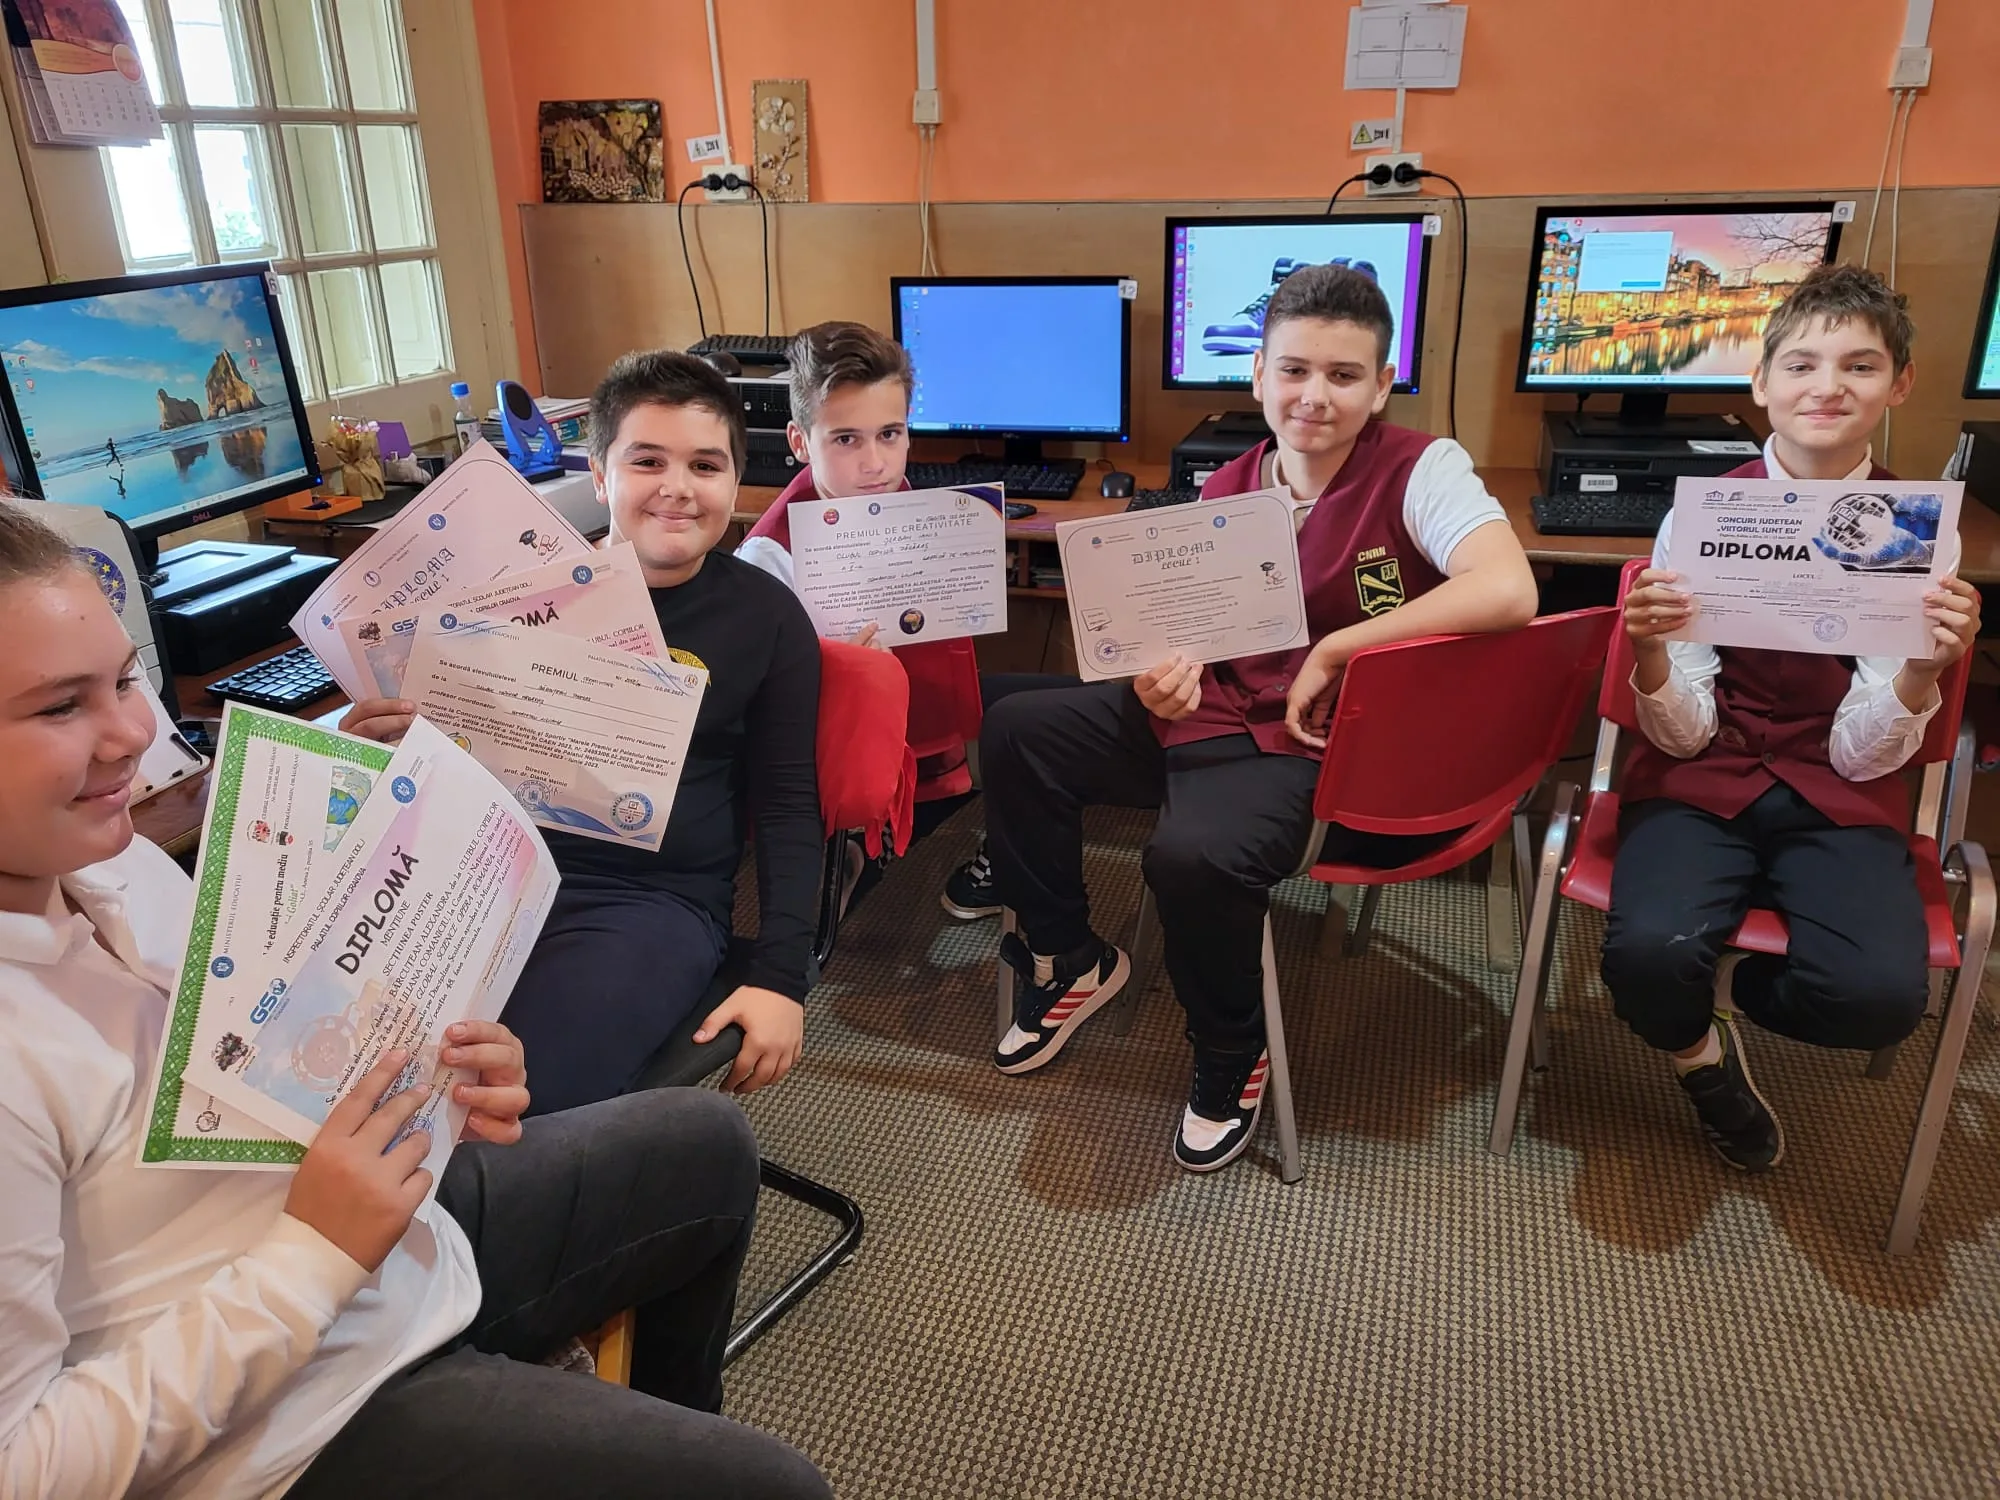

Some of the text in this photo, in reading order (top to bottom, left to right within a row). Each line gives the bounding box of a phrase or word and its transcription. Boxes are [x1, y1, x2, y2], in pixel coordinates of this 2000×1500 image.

[268, 278, 278, 293] 6
[837, 519, 972, 540] PREMIUL DE CREATIVITATE
[1130, 537, 1215, 567] DIPLOMA
[1357, 546, 1387, 563] CNRN
[1700, 542, 1811, 562] DIPLOMA
[530, 660, 580, 683] PREMIUL
[274, 852, 289, 878] mediu
[272, 879, 287, 906] pentru
[309, 922, 332, 952] PALATUL
[345, 865, 367, 894] CRAIOVA
[328, 843, 422, 976] DIPLOMĂ
[408, 889, 435, 926] POSTER
[220, 912, 236, 954] MINISTERUL
[264, 905, 282, 939] educație
[281, 909, 321, 965] INSPECTORATUL
[413, 961, 440, 1000] GLOBAL
[433, 922, 460, 961] SCIENCE
[453, 893, 475, 923] OPERA
[324, 1091, 338, 1106] Se
[416, 888, 454, 943] ALEXANDRA
[447, 878, 457, 890] de
[456, 836, 481, 871] CLUBUL
[397, 966, 424, 1005] LILIANA
